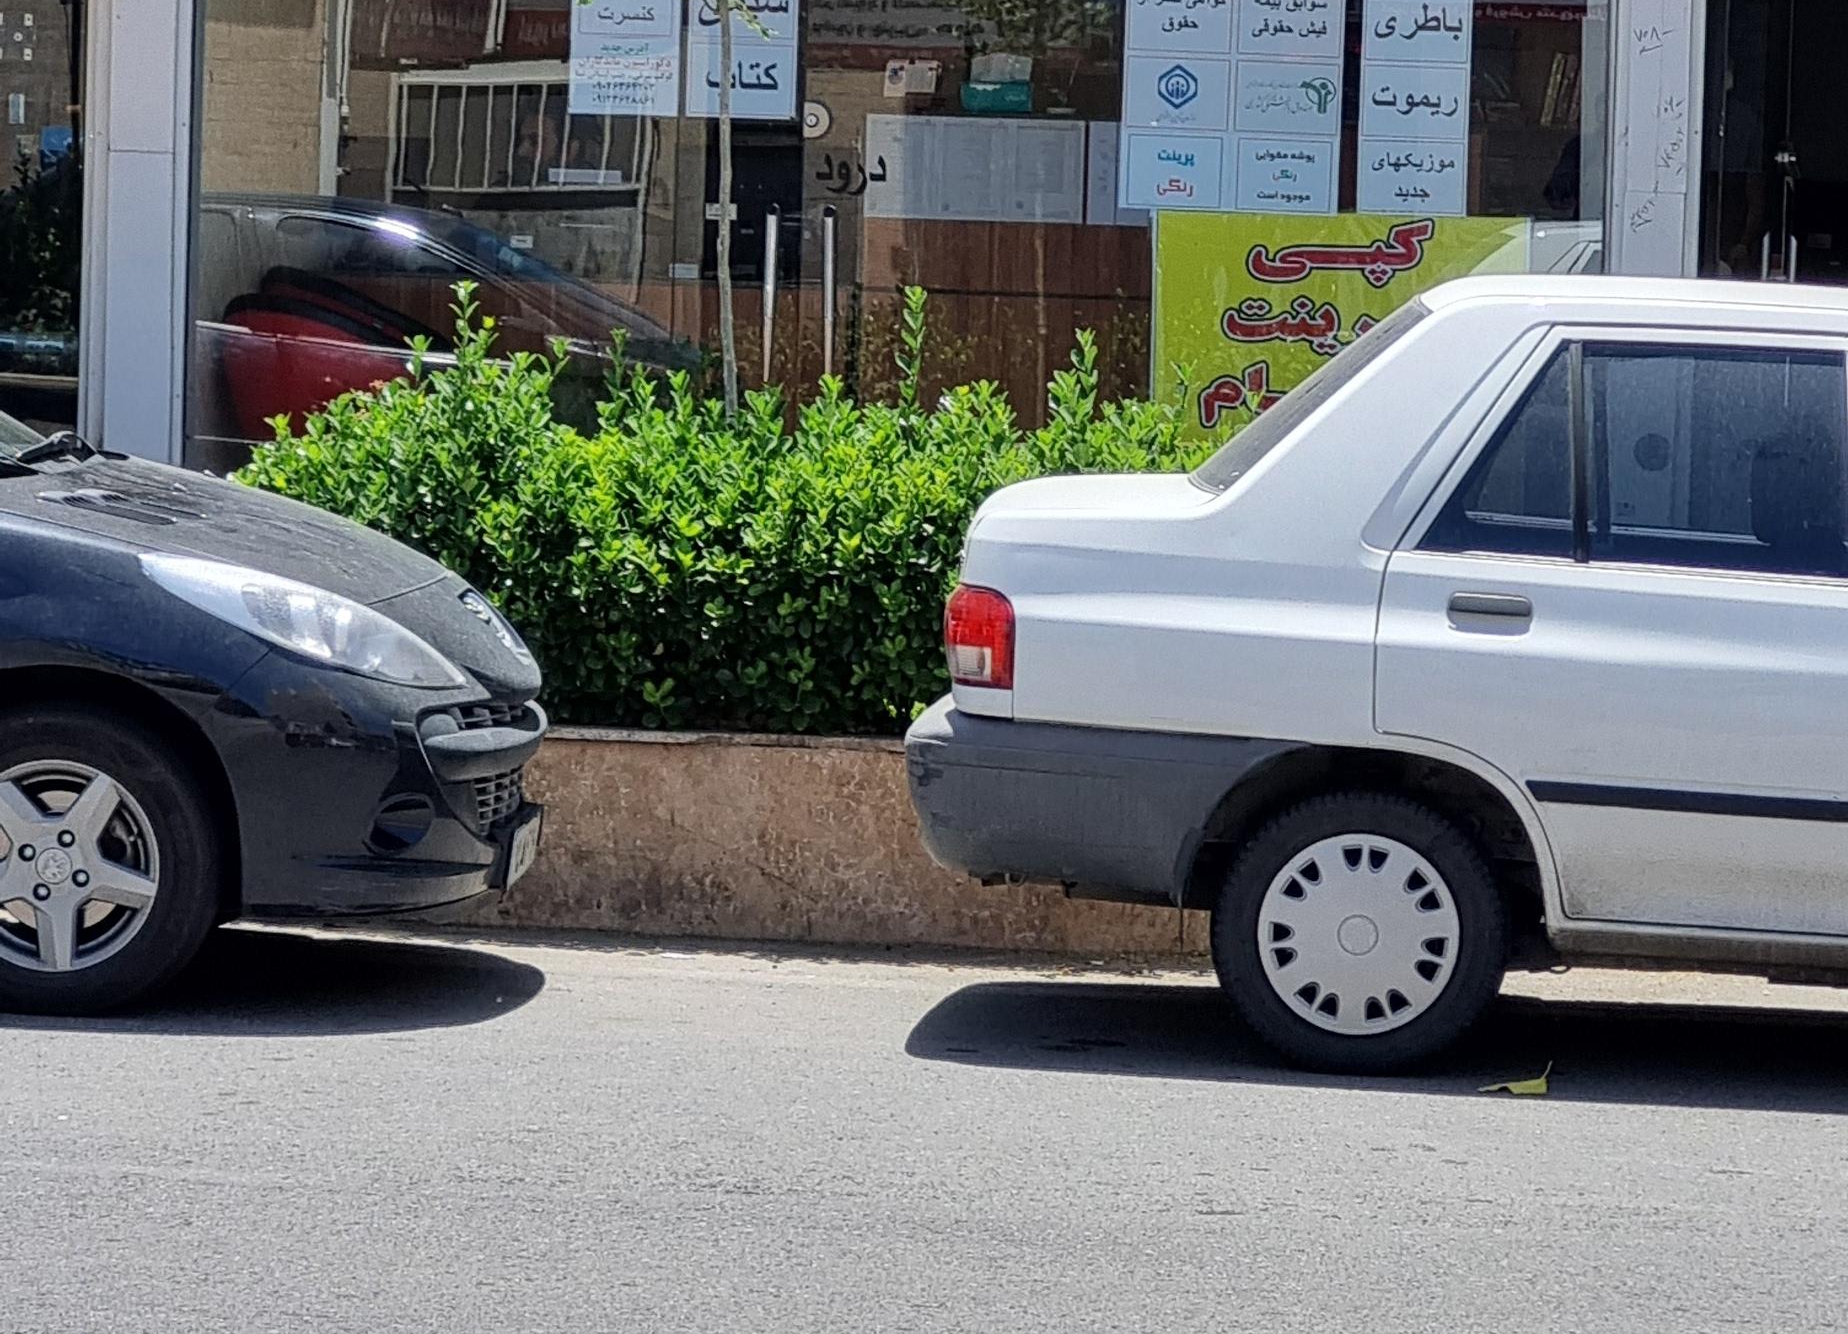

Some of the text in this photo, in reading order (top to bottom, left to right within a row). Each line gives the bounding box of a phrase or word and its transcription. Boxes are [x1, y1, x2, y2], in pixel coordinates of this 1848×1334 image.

[597, 6, 656, 25] کنسرت
[1161, 15, 1199, 32] حقوق
[1374, 3, 1463, 41] باطری
[1252, 18, 1328, 38] فیش حقوقی
[706, 60, 779, 97] کتاب
[1371, 86, 1459, 117] ریموت
[1157, 148, 1195, 167] پرینت
[1291, 149, 1316, 164] پوشه
[1371, 152, 1455, 173] موزیکهای
[815, 152, 888, 195] درود
[1156, 178, 1194, 197] رنگی
[1256, 190, 1311, 203] موجود است
[1394, 186, 1430, 203] جدید
[1247, 219, 1435, 287] کپی
[1222, 296, 1378, 358] ینت
